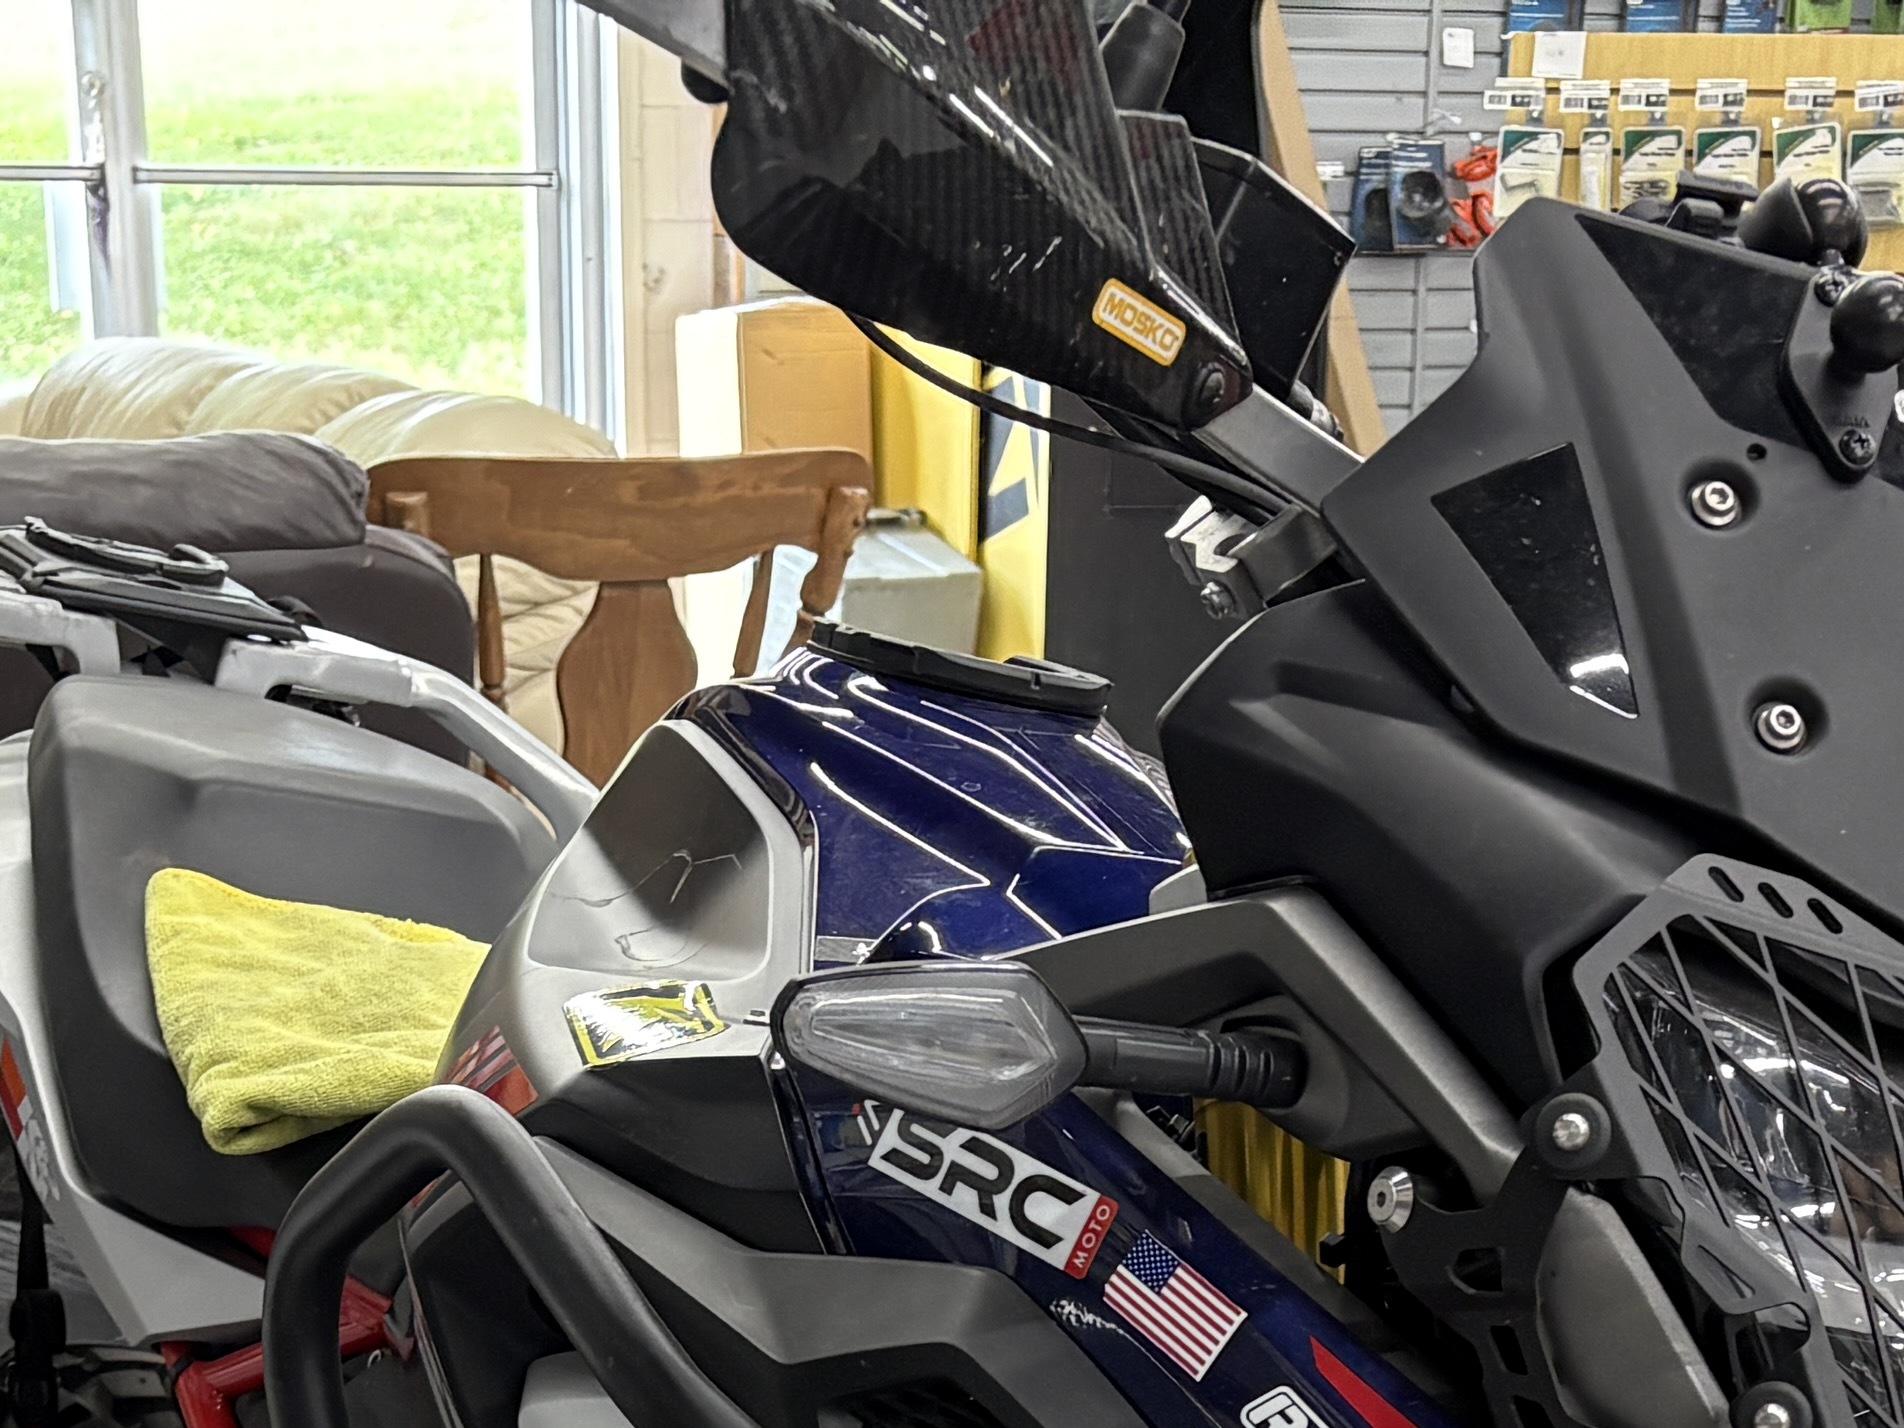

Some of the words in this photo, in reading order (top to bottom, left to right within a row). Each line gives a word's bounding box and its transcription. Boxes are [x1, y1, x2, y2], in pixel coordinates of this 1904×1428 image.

[1102, 291, 1180, 352] MOSKO
[881, 1109, 1090, 1250] SRC
[1074, 1203, 1112, 1271] MOTO
